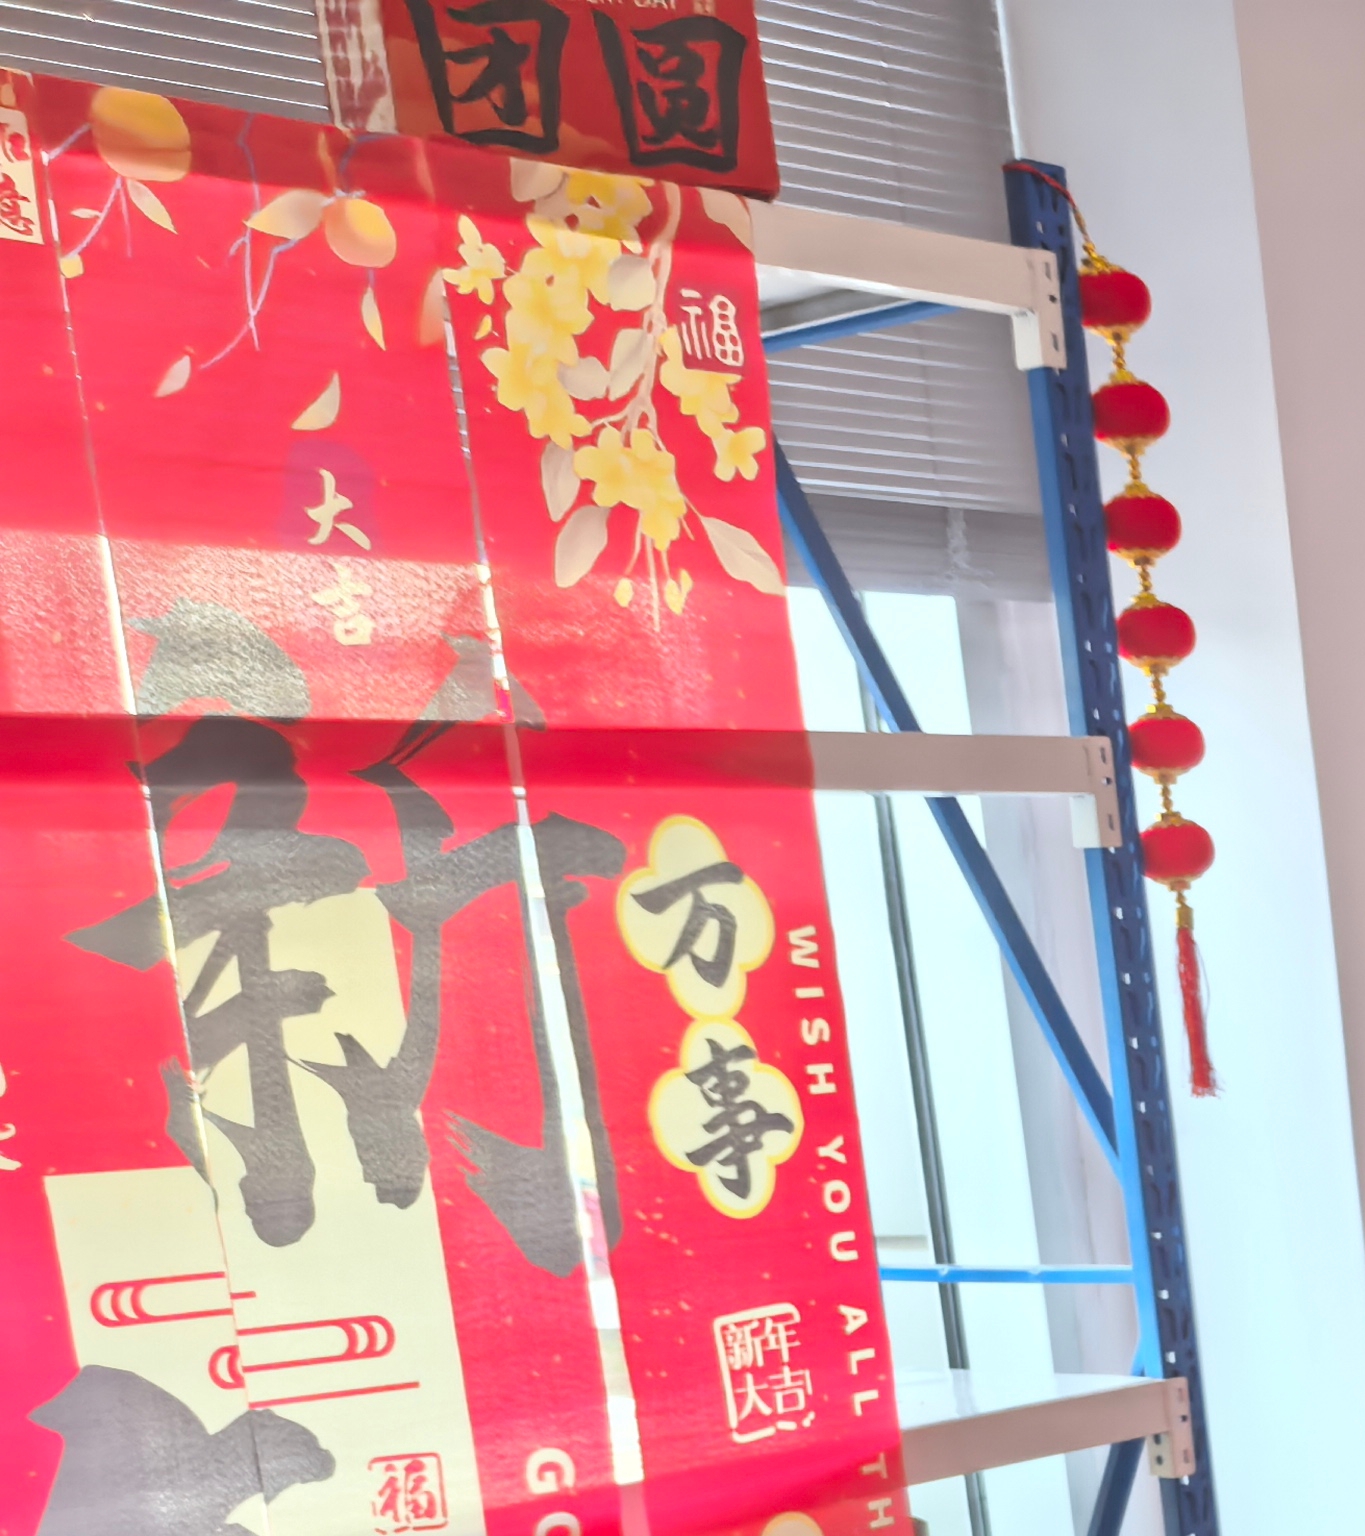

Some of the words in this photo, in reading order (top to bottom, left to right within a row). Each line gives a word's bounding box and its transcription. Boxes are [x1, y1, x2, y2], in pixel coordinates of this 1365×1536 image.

[679, 288, 745, 367] 福
[303, 466, 376, 646] 大吉
[630, 860, 795, 1200] 万事
[787, 924, 838, 1097] WISH
[816, 1133, 860, 1263] YOU
[837, 1303, 880, 1418] ALL
[378, 1458, 438, 1524] 福
